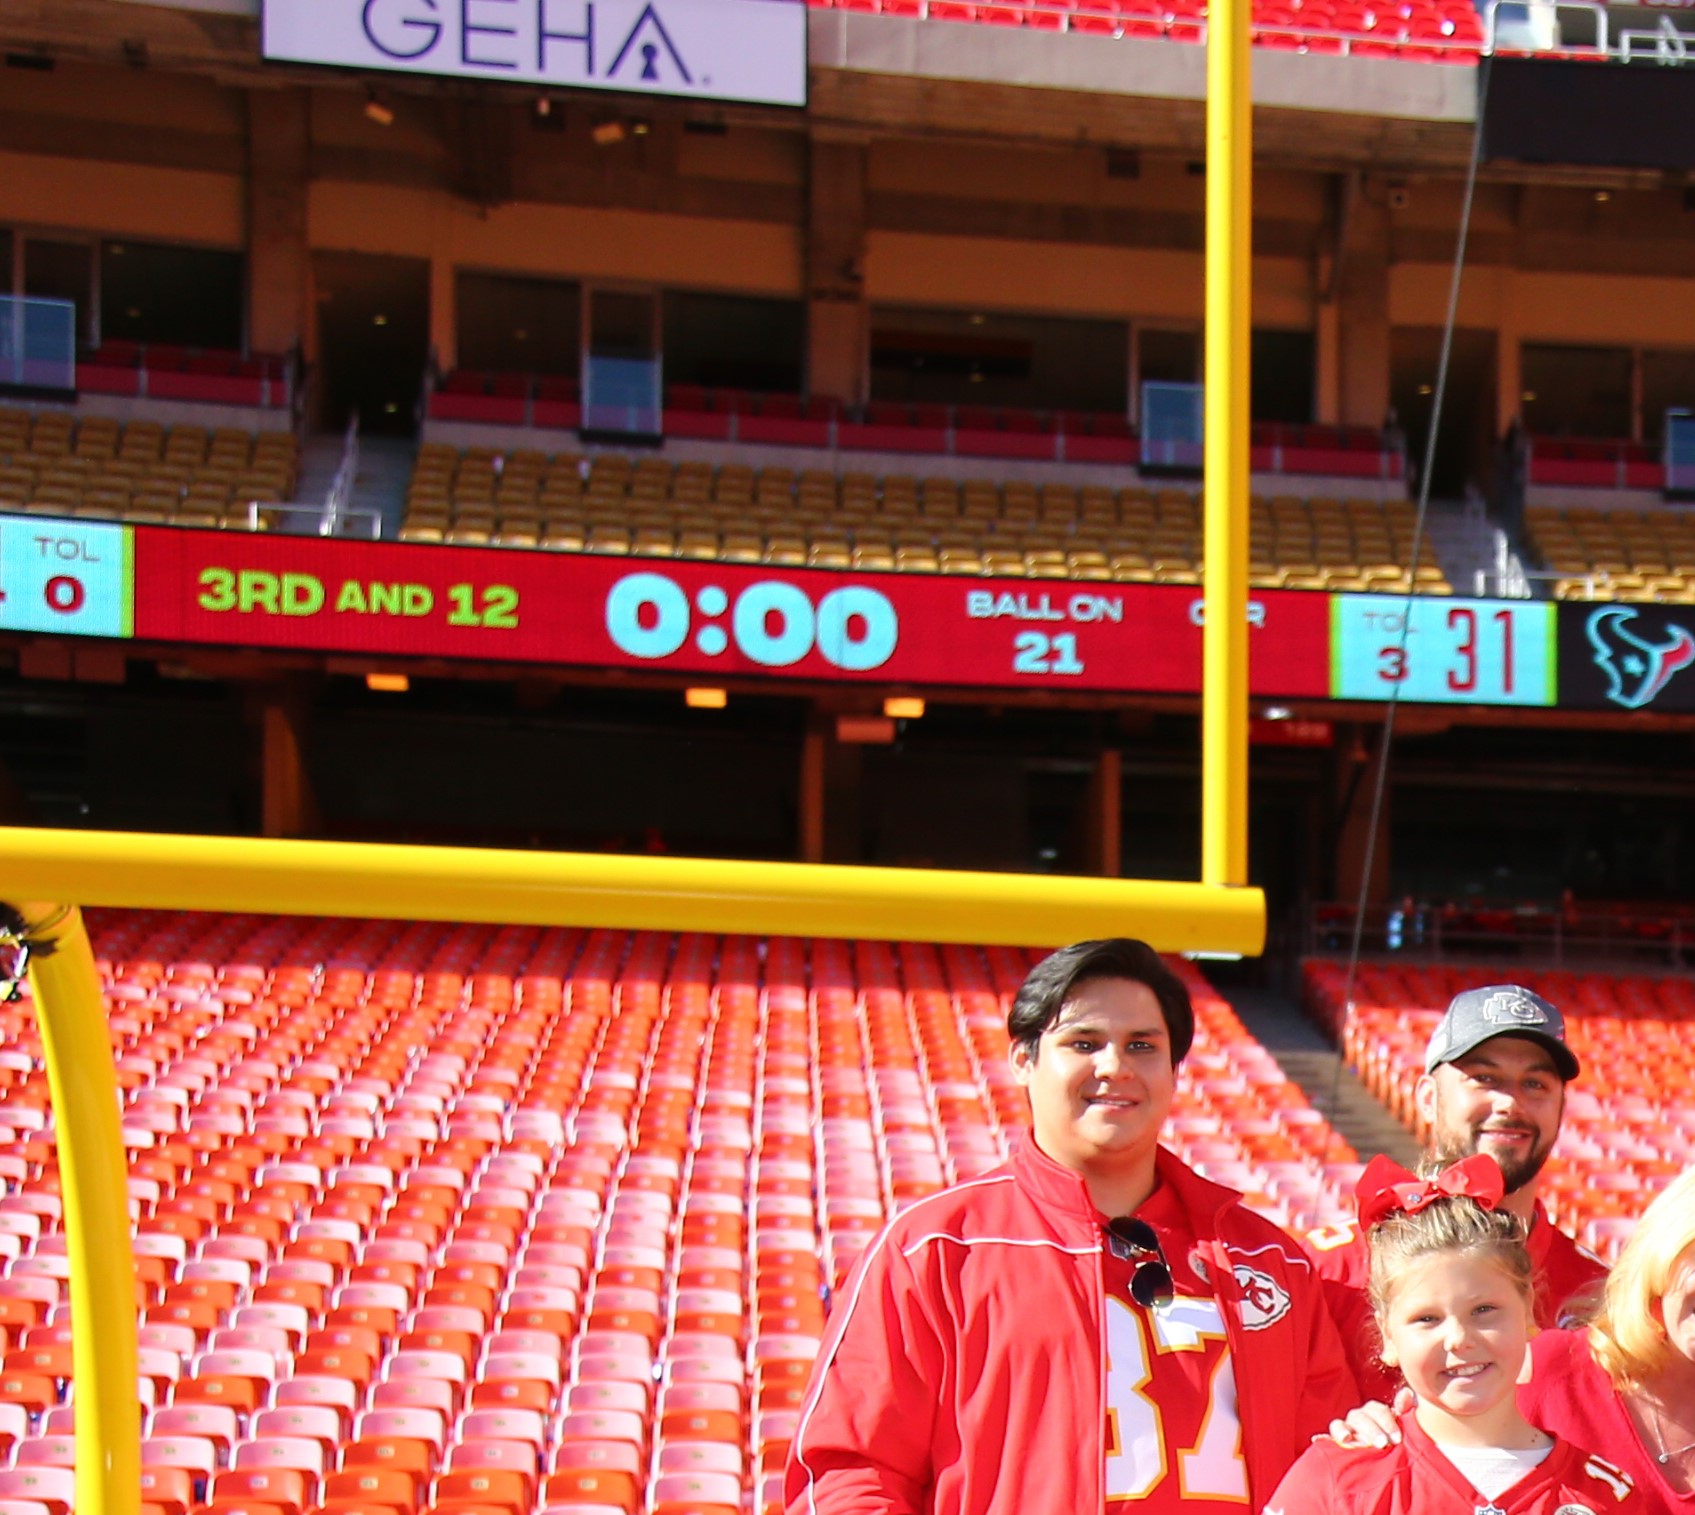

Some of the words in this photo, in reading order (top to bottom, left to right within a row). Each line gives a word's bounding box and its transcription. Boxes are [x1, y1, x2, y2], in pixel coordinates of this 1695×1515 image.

[362, 0, 693, 85] GEHA
[34, 535, 101, 563] TOL
[43, 576, 85, 613] 0
[198, 567, 326, 616] 3RD
[336, 581, 434, 616] AND
[447, 584, 519, 629] 12
[966, 588, 1066, 621] BALL
[1068, 594, 1123, 624] ON
[605, 572, 898, 671] 0:00
[1013, 630, 1084, 675] 21
[1377, 646, 1409, 681] 3
[1446, 608, 1515, 693] 31
